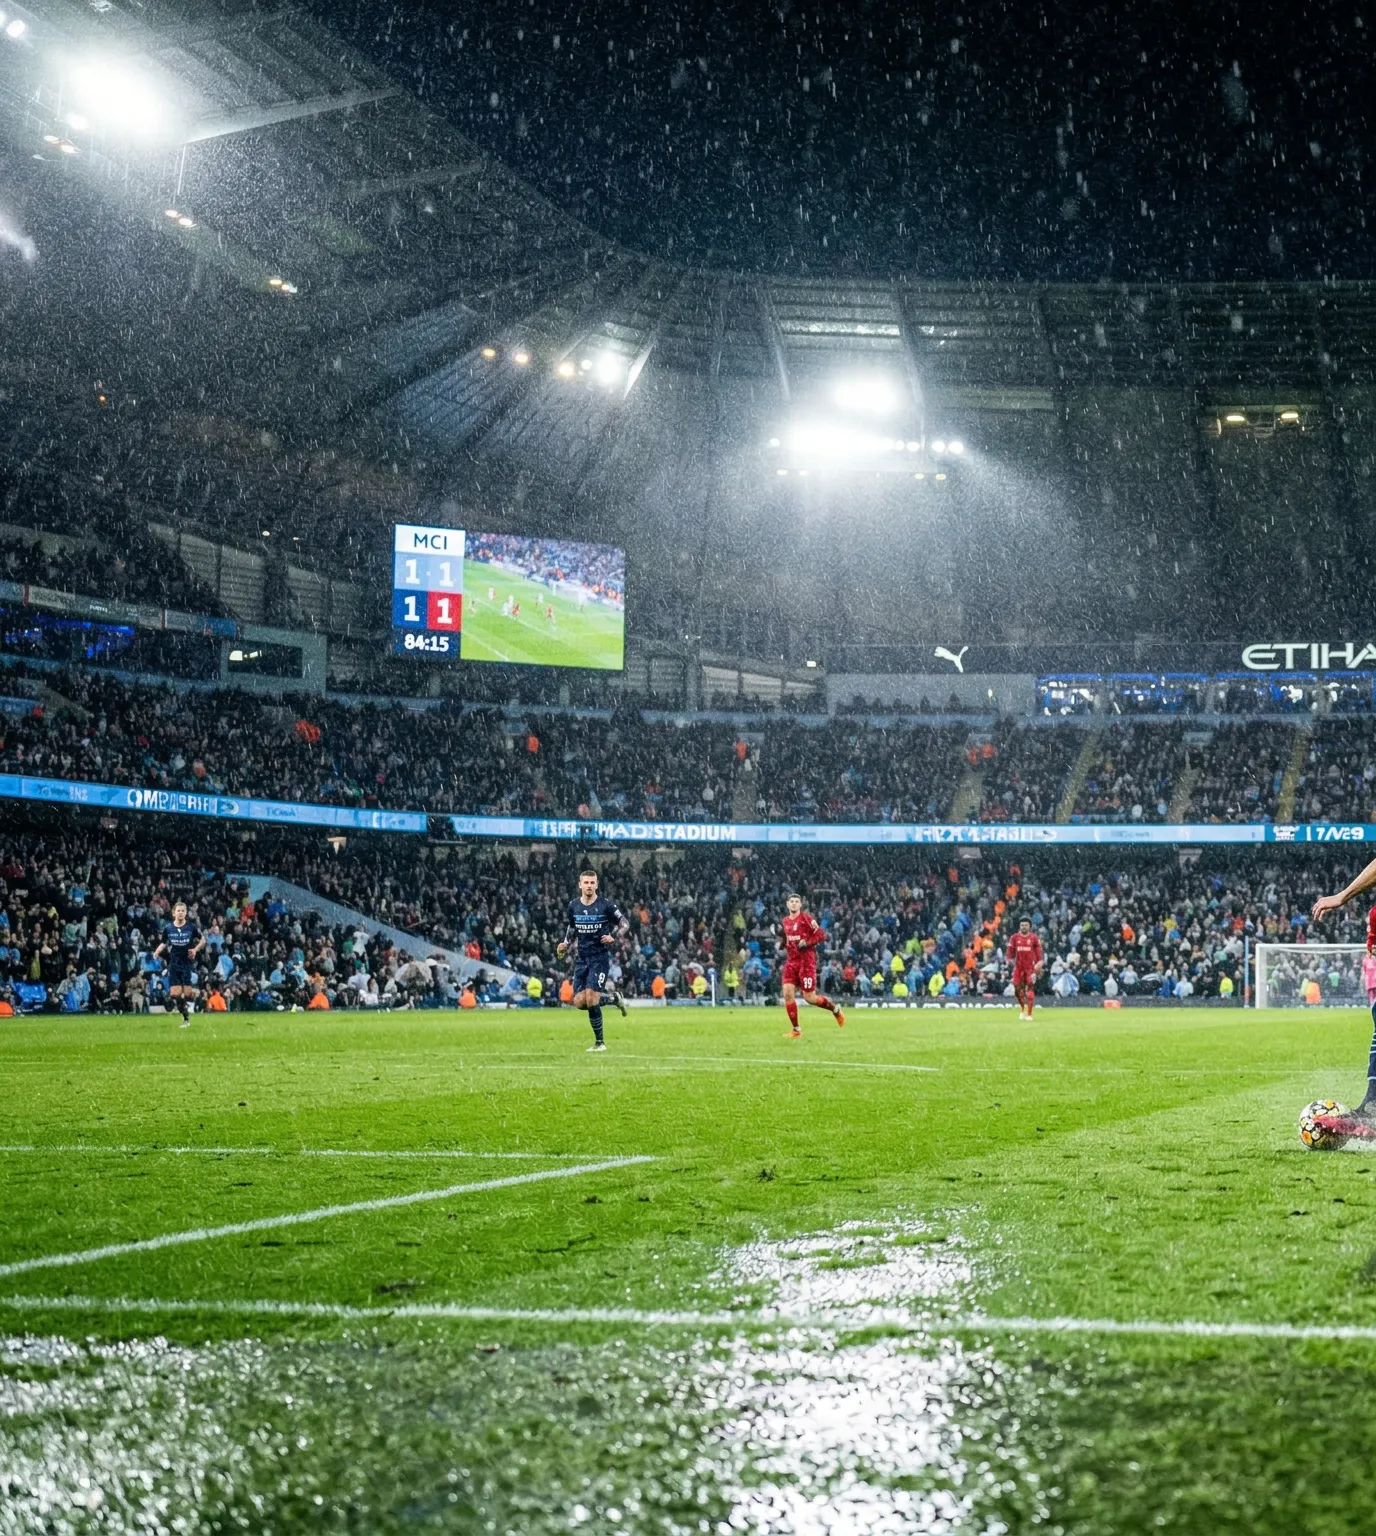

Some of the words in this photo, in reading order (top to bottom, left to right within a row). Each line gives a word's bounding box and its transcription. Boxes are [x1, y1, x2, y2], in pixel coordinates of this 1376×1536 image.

[413, 533, 448, 550] MCI
[405, 558, 420, 585] 1
[439, 561, 454, 587] 1
[404, 595, 420, 621] 1
[437, 598, 453, 624] 1
[404, 633, 450, 652] 84:15
[654, 824, 737, 841] STADIUM
